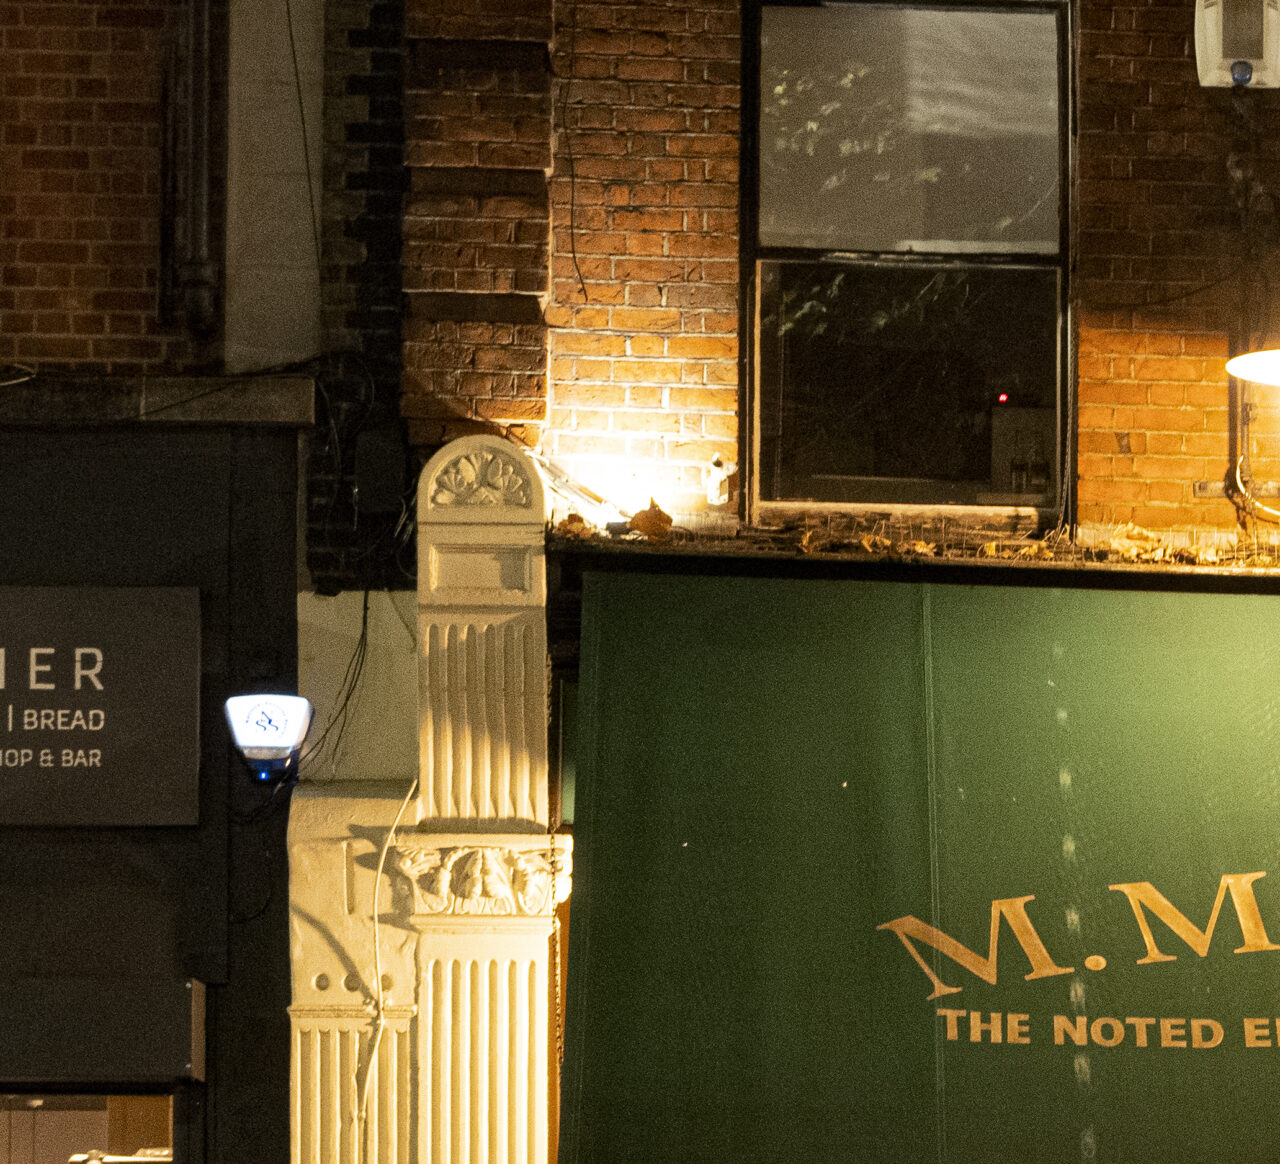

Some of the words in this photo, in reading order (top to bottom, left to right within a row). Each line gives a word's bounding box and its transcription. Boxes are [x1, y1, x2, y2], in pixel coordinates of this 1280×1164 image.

[23, 708, 105, 731] BREAD
[0, 748, 33, 767] OP
[40, 748, 54, 767] &
[61, 748, 102, 767] BAR
[937, 1008, 1031, 1045] THE
[1053, 1015, 1225, 1049] NOTED
